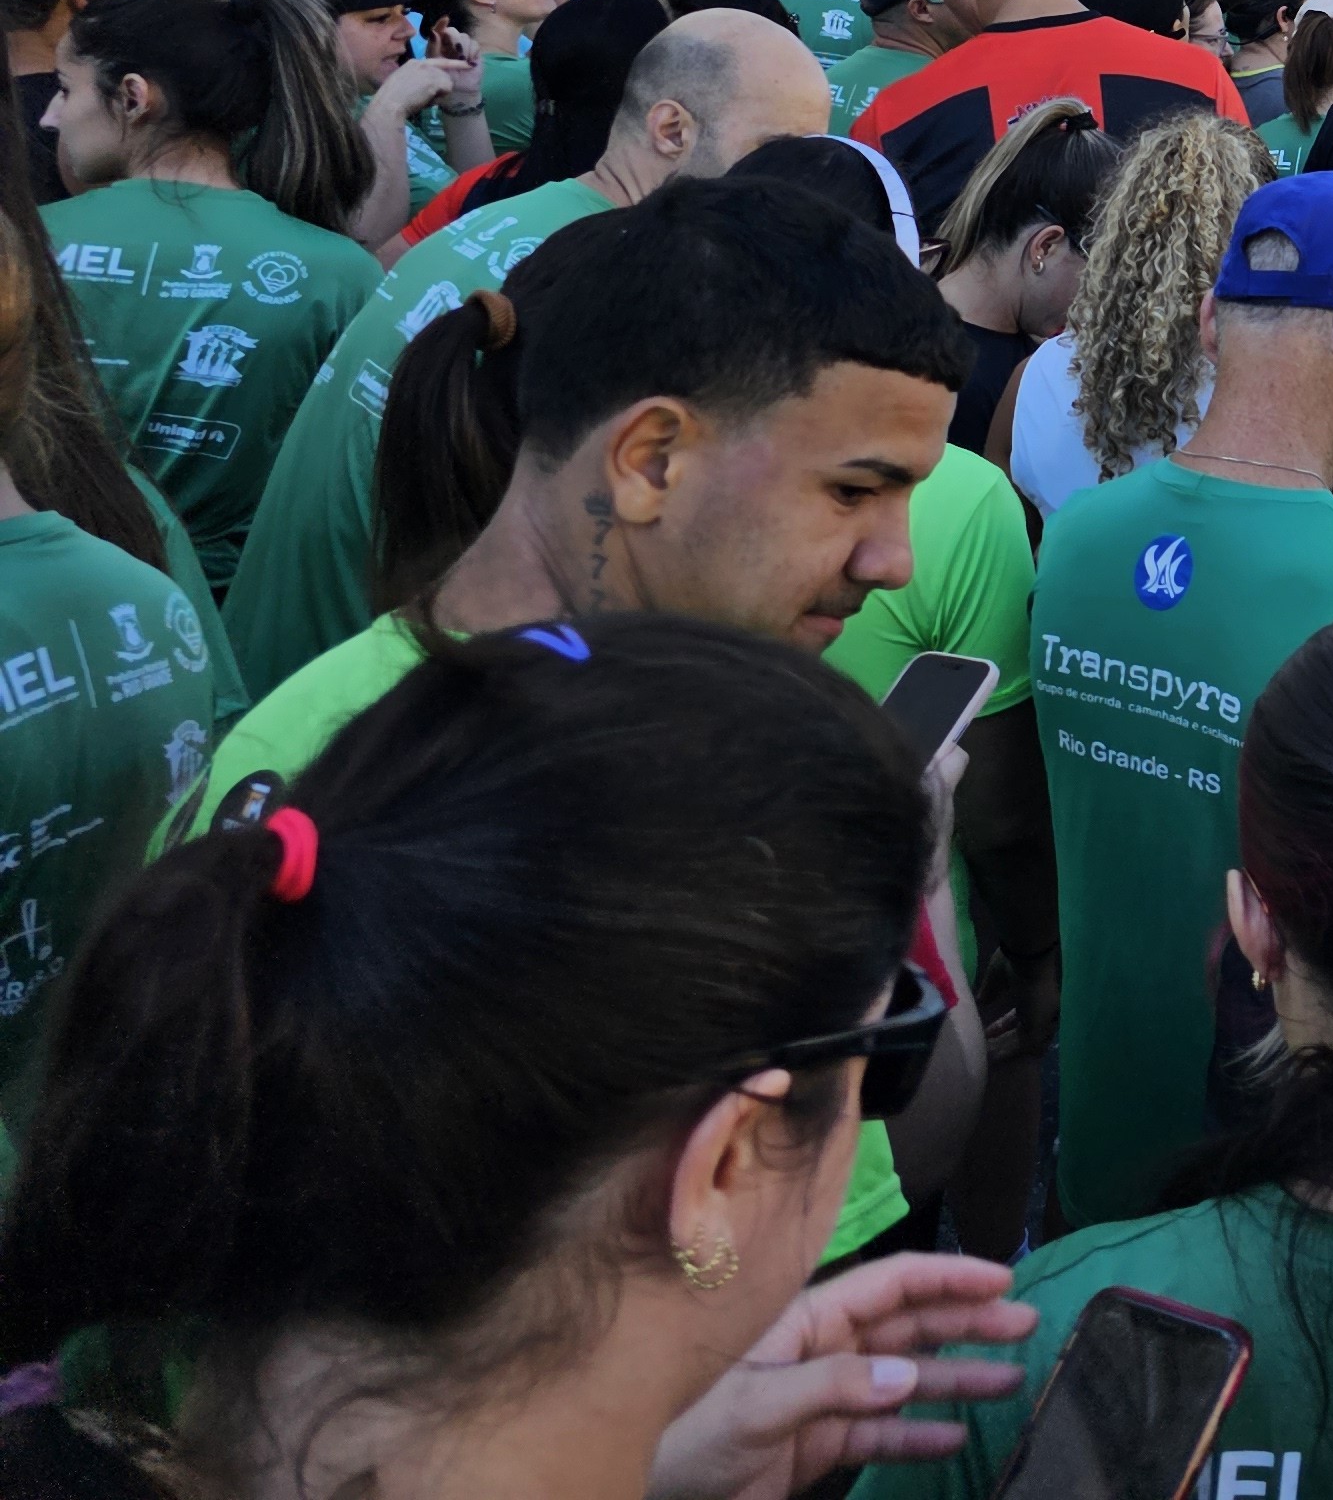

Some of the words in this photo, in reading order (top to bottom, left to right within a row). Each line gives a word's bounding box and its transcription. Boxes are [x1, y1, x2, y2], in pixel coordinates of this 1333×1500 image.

[57, 243, 136, 277] MEL
[1042, 634, 1242, 724] Transpyre
[1058, 728, 1086, 757] Rio
[1090, 741, 1169, 780] Grande
[1188, 767, 1222, 795] RS
